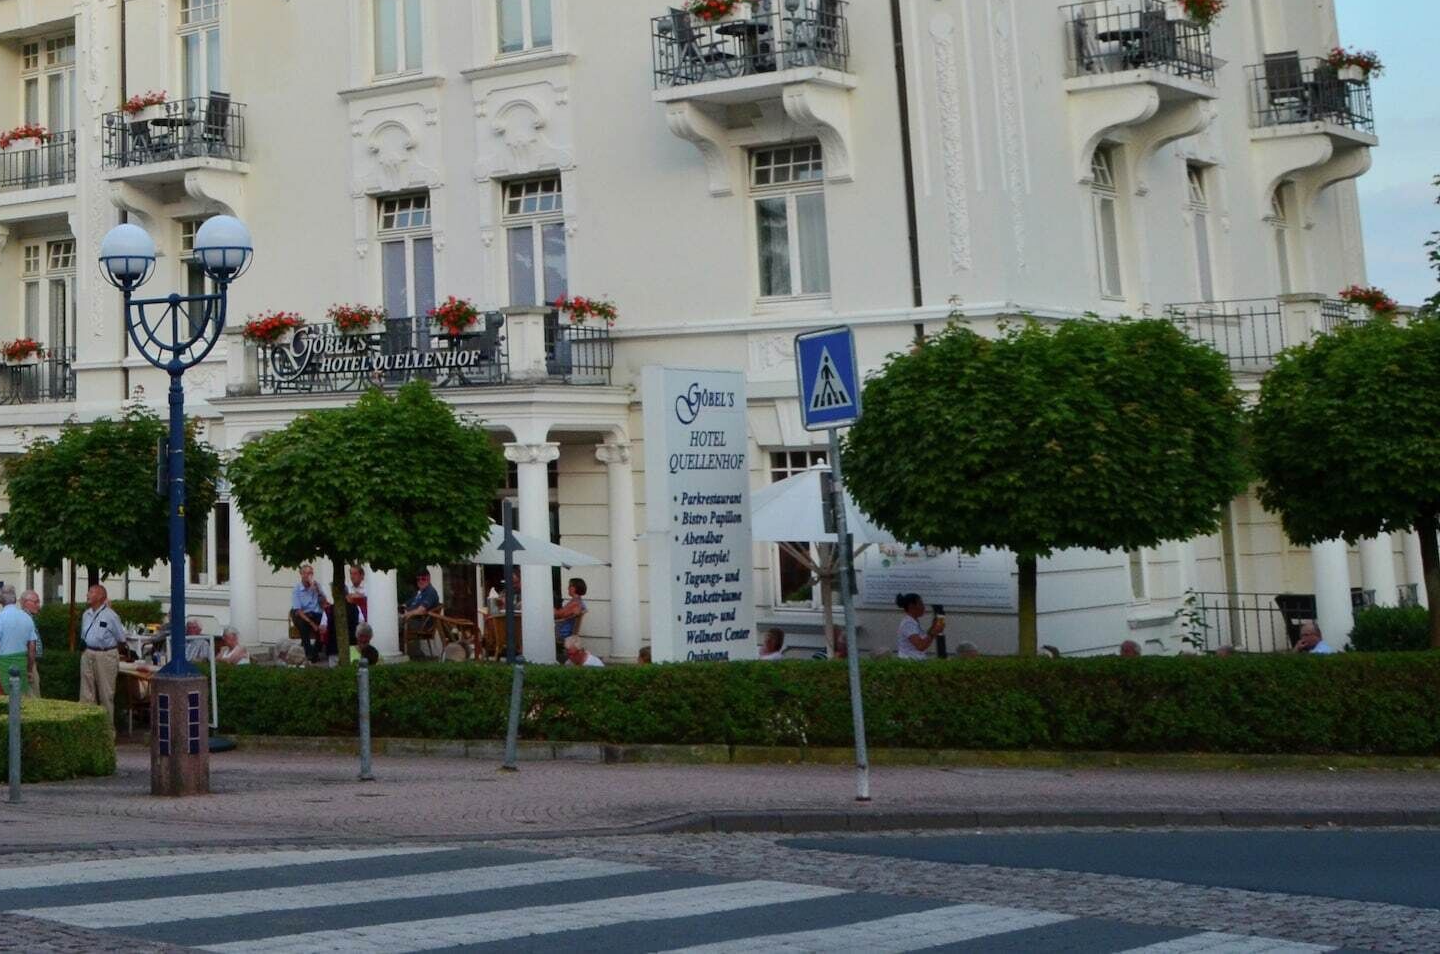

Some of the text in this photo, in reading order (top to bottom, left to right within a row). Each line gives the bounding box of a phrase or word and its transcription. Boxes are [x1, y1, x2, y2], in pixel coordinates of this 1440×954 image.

[320, 349, 480, 372] HOTEL QUELLENHOF
[689, 431, 727, 446] HOTEL
[669, 453, 745, 474] QUELLENHOF
[681, 492, 742, 505] Parkrestaurant
[682, 510, 742, 527] Bistro Papillon
[682, 531, 723, 545] Abendbar
[692, 549, 730, 567] Lifestyle!
[685, 568, 740, 588] Tagungs- und
[685, 590, 742, 605] Banketträume
[685, 607, 736, 626] Beauty- und
[687, 627, 750, 644] Wellness Center
